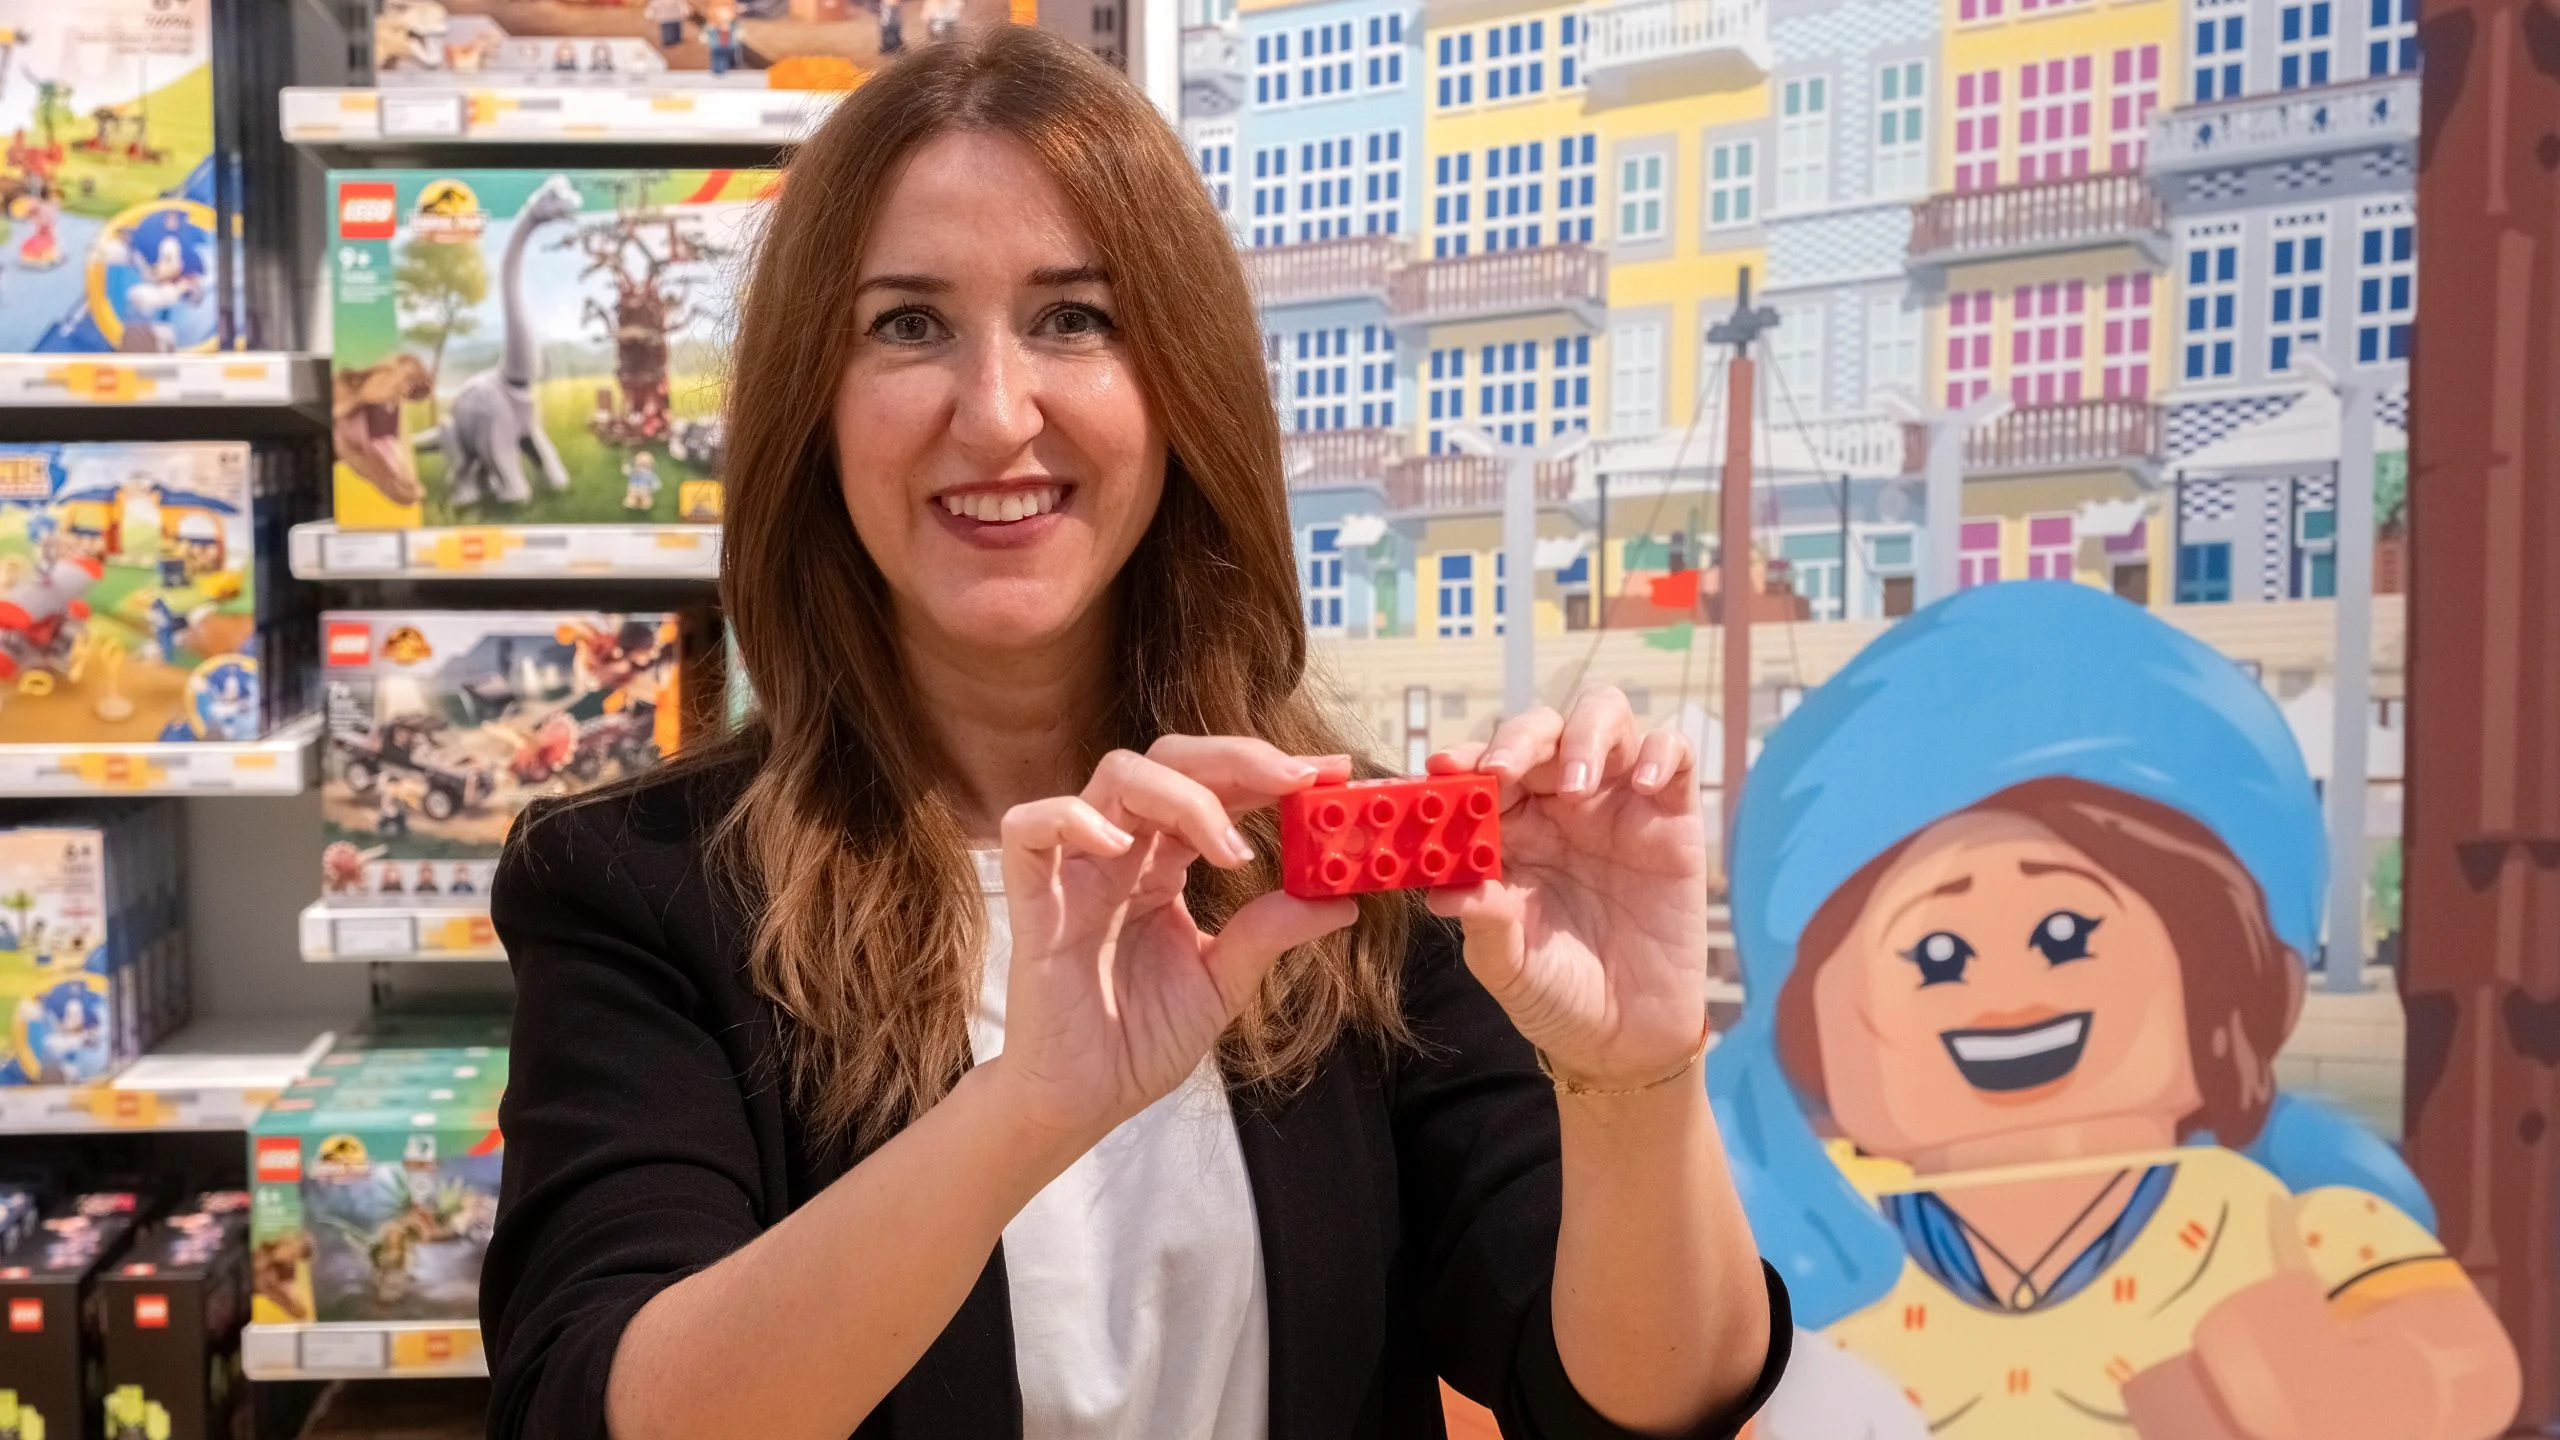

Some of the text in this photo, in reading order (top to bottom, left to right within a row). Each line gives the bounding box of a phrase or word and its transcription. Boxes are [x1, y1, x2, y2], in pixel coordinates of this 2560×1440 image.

[342, 197, 395, 223] LEGO
[331, 634, 370, 654] LEGO
[259, 1148, 300, 1170] LEGO
